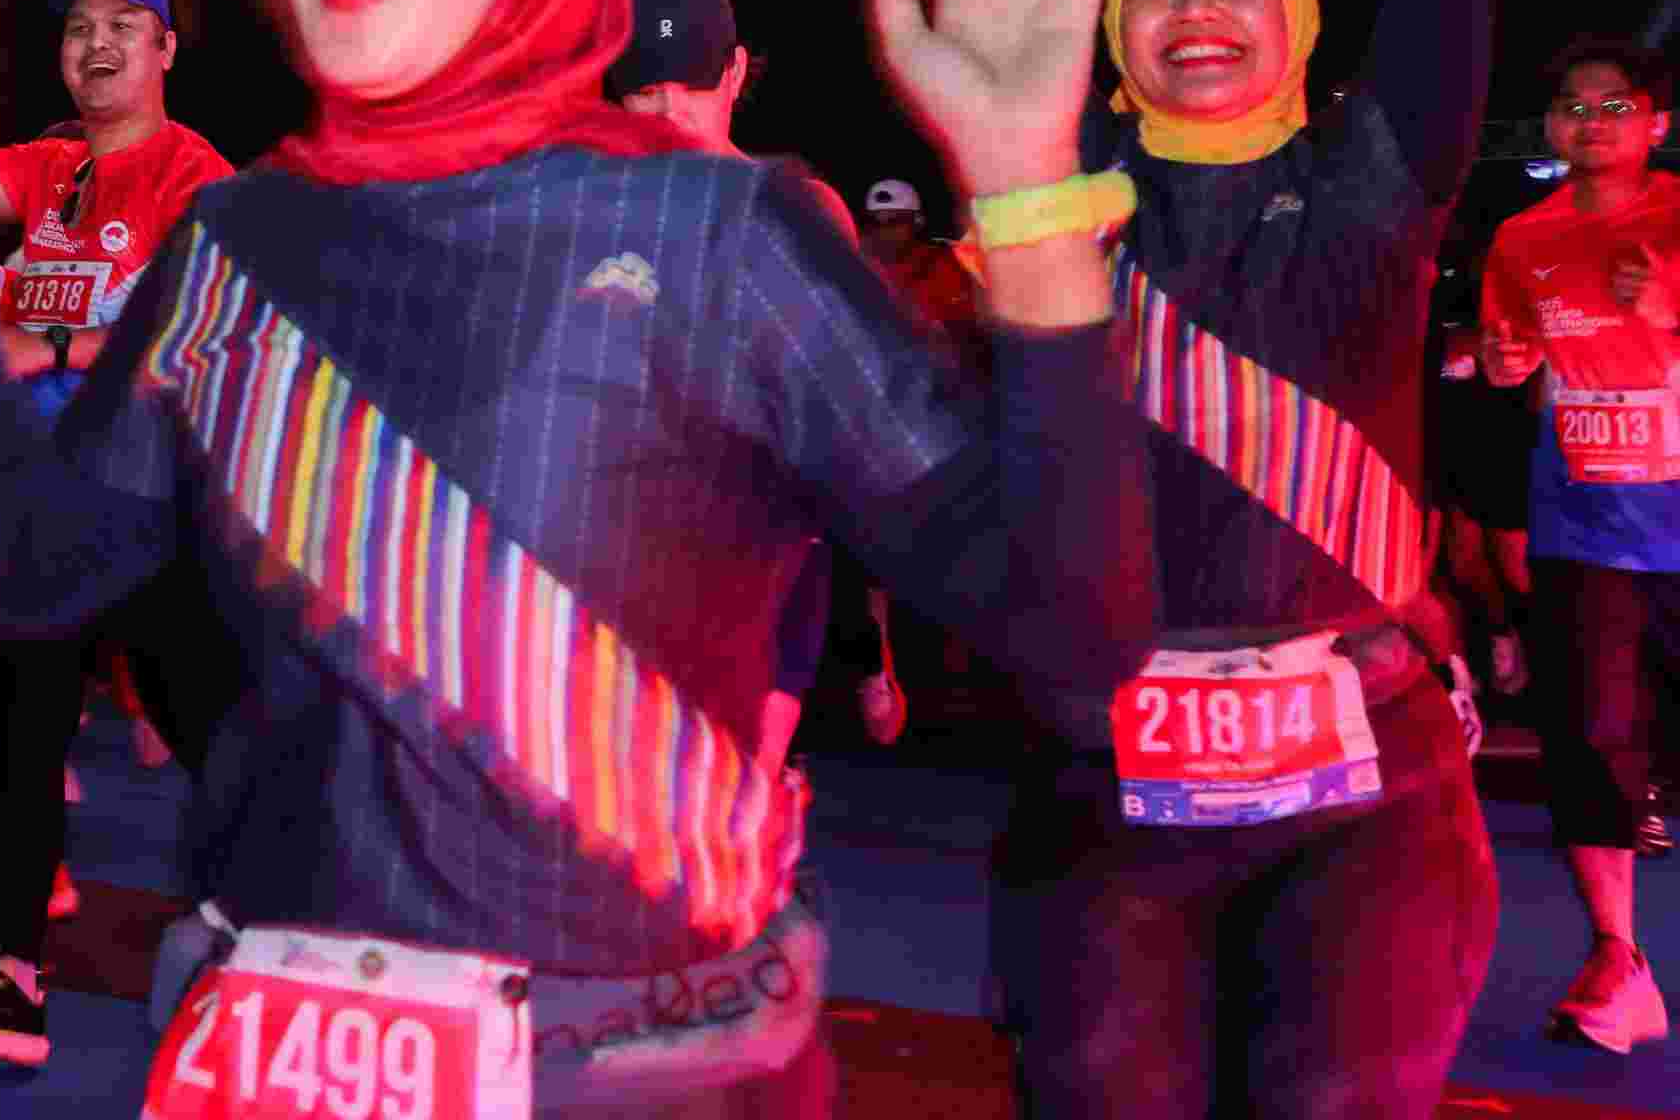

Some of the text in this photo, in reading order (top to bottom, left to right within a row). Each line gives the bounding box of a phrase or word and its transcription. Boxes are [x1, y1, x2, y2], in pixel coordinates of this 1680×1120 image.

[17, 280, 85, 311] 31318
[1563, 410, 1649, 446] 20013
[1136, 686, 1316, 753] 21814
[175, 990, 433, 1120] 21499
